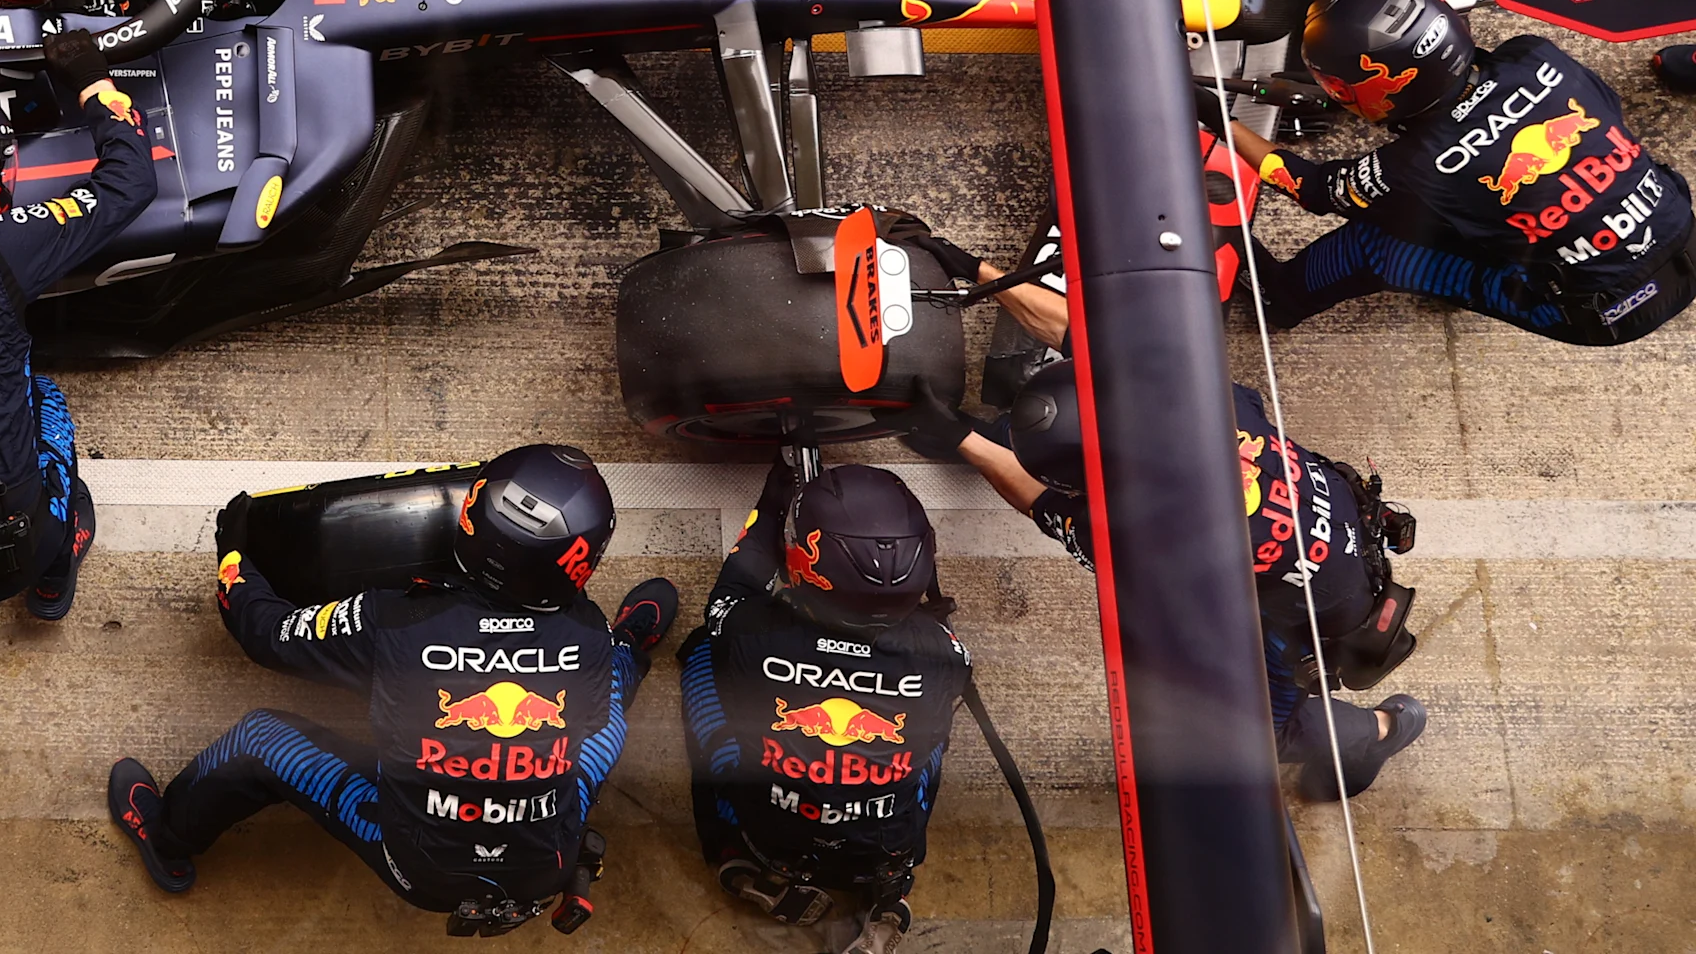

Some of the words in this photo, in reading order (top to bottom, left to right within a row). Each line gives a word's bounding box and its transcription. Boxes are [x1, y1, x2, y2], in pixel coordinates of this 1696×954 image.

[379, 32, 525, 63] BYBIT
[108, 69, 157, 78] VERSTAPPEN
[214, 47, 234, 102] PEPE
[1434, 61, 1564, 175] ORACLE
[1450, 79, 1498, 123] sparco
[216, 105, 236, 174] JEANS
[262, 182, 280, 216] RAUCH
[1505, 172, 1595, 244] Red
[1571, 125, 1642, 195] Bull
[1556, 191, 1653, 266] Mobil
[865, 246, 881, 345] BRAKES
[1281, 496, 1332, 590] Mobil
[477, 616, 536, 634] sparco
[815, 636, 872, 659] sparco
[421, 644, 581, 674] ORACLE
[761, 655, 924, 697] ORACLE
[416, 736, 502, 781] Red
[505, 736, 574, 782] Bull
[760, 736, 835, 786] Red
[840, 750, 913, 786] Bull
[425, 788, 528, 825] Mobil
[769, 782, 862, 826] Mobil
[1109, 670, 1148, 954] REDBULLRACING.COM
